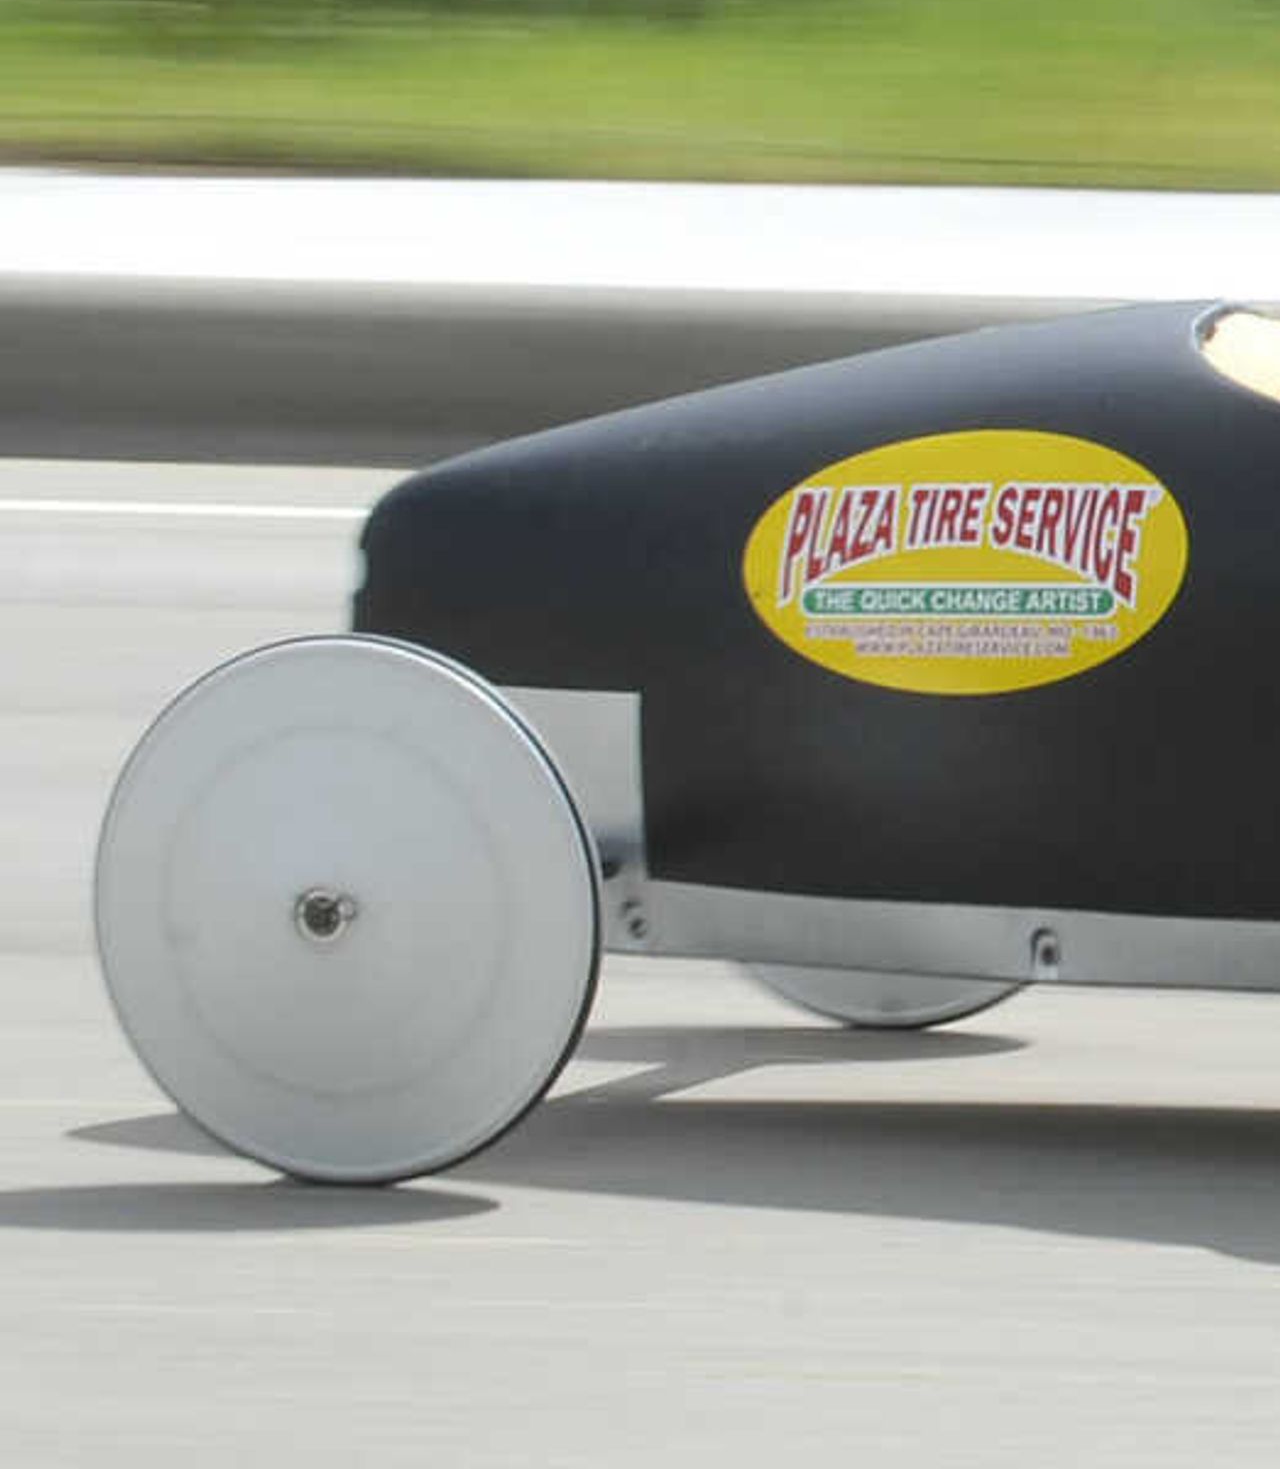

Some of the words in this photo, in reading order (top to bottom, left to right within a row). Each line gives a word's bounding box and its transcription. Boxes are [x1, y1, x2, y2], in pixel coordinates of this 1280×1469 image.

[780, 487, 897, 601] PLAZA
[907, 487, 987, 545] TIRE
[992, 487, 1146, 600] SERVICE
[814, 590, 858, 611] THE
[860, 590, 925, 613] QUICK
[929, 590, 1020, 613] CHANGE
[1024, 591, 1101, 613] ARTIST
